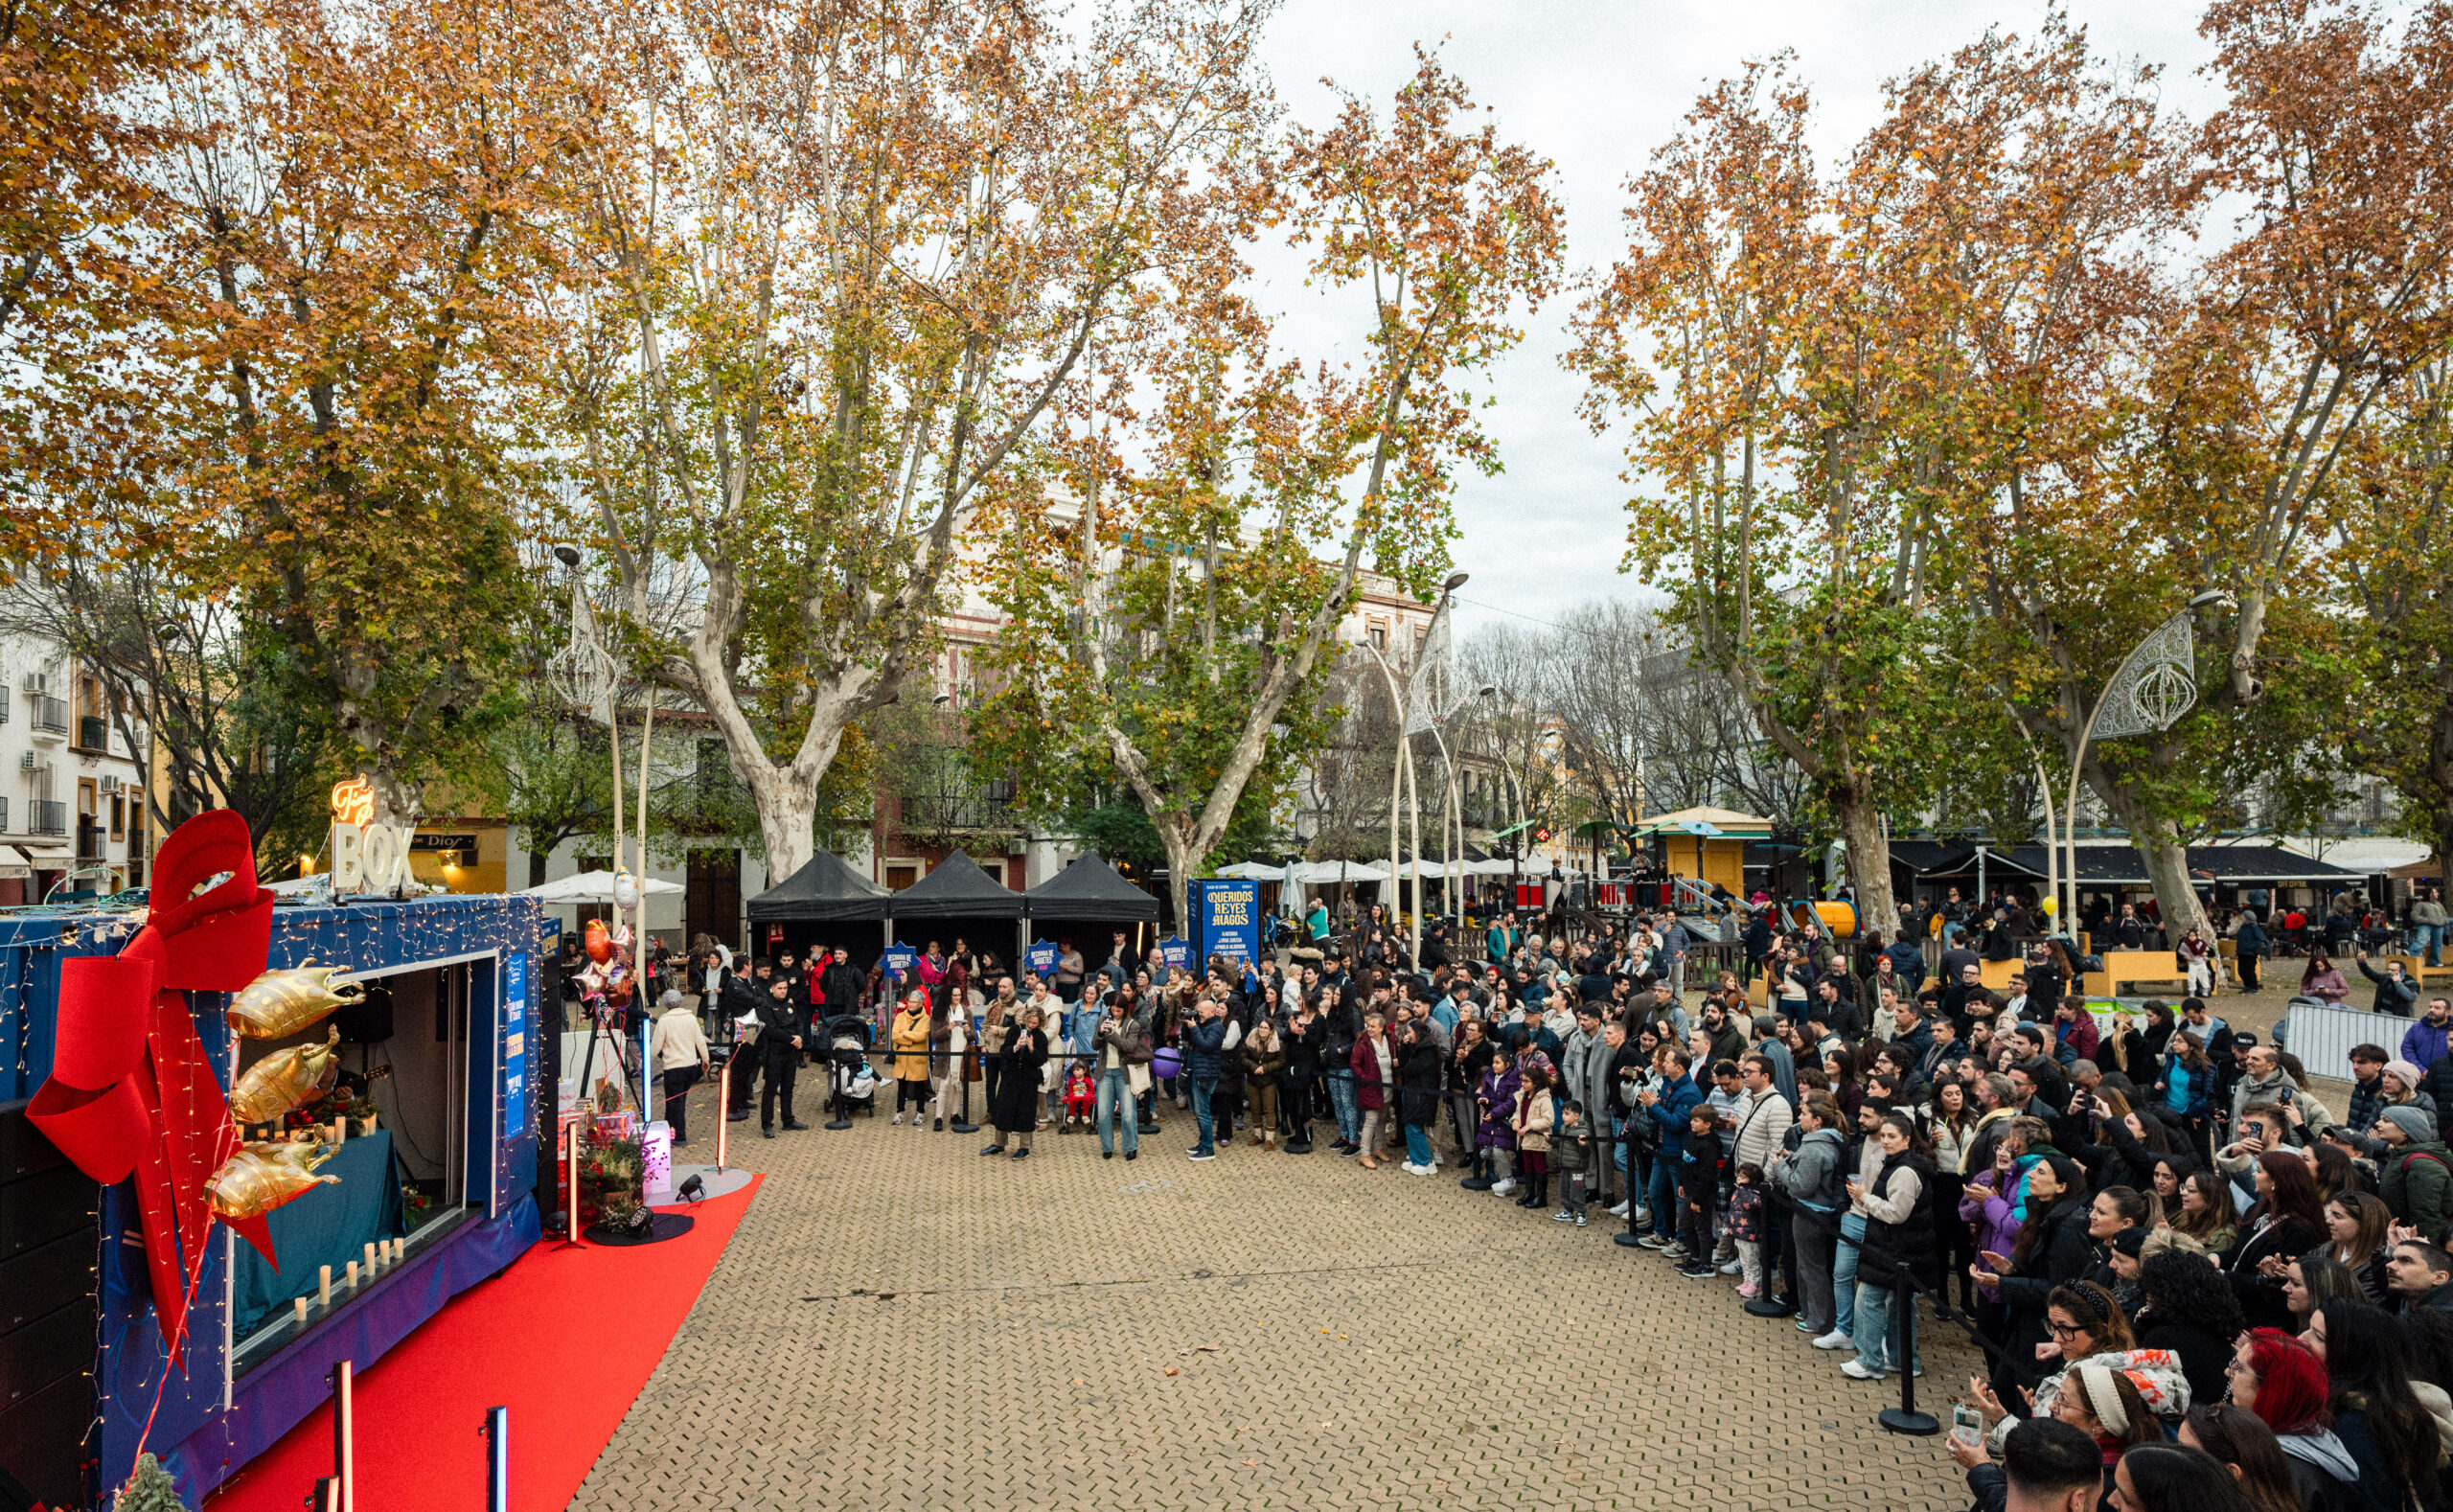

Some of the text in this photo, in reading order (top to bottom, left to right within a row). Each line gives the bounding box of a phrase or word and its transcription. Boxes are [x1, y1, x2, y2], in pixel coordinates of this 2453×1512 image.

[332, 773, 374, 828] Tiny
[334, 822, 416, 887] BOX
[1207, 891, 1253, 903] QUERIDOS
[1214, 903, 1247, 914] REYES
[1212, 914, 1249, 926] MAGOS
